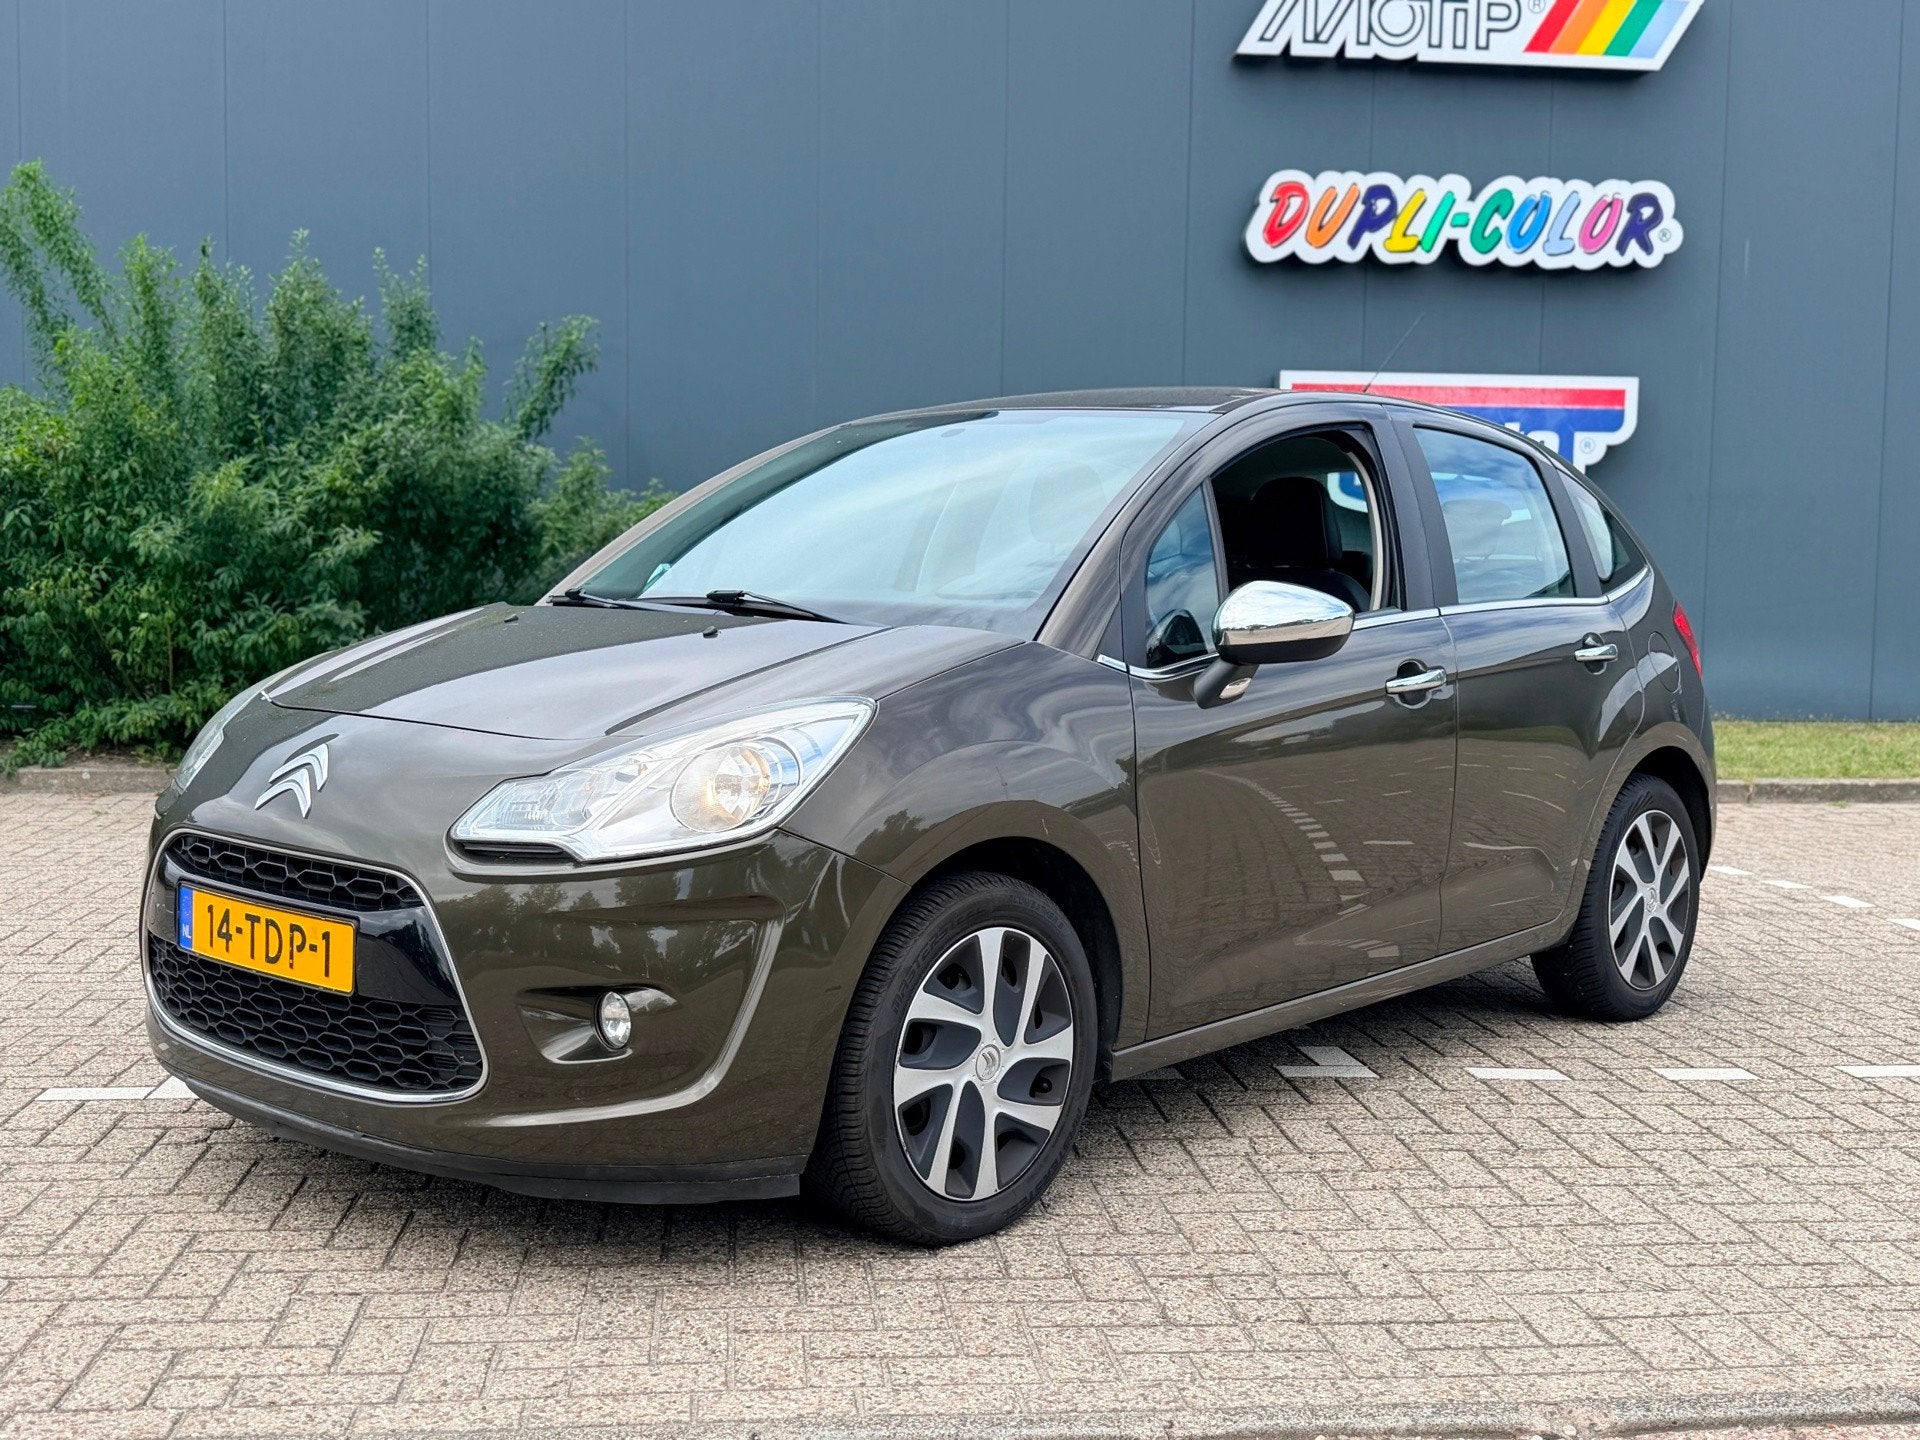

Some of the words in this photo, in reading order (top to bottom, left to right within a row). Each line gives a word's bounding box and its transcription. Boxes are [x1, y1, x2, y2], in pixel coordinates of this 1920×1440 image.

[1262, 181, 1665, 256] DUPLI-COLOR
[182, 923, 192, 939] NL
[207, 903, 332, 978] 14-TDP-1
